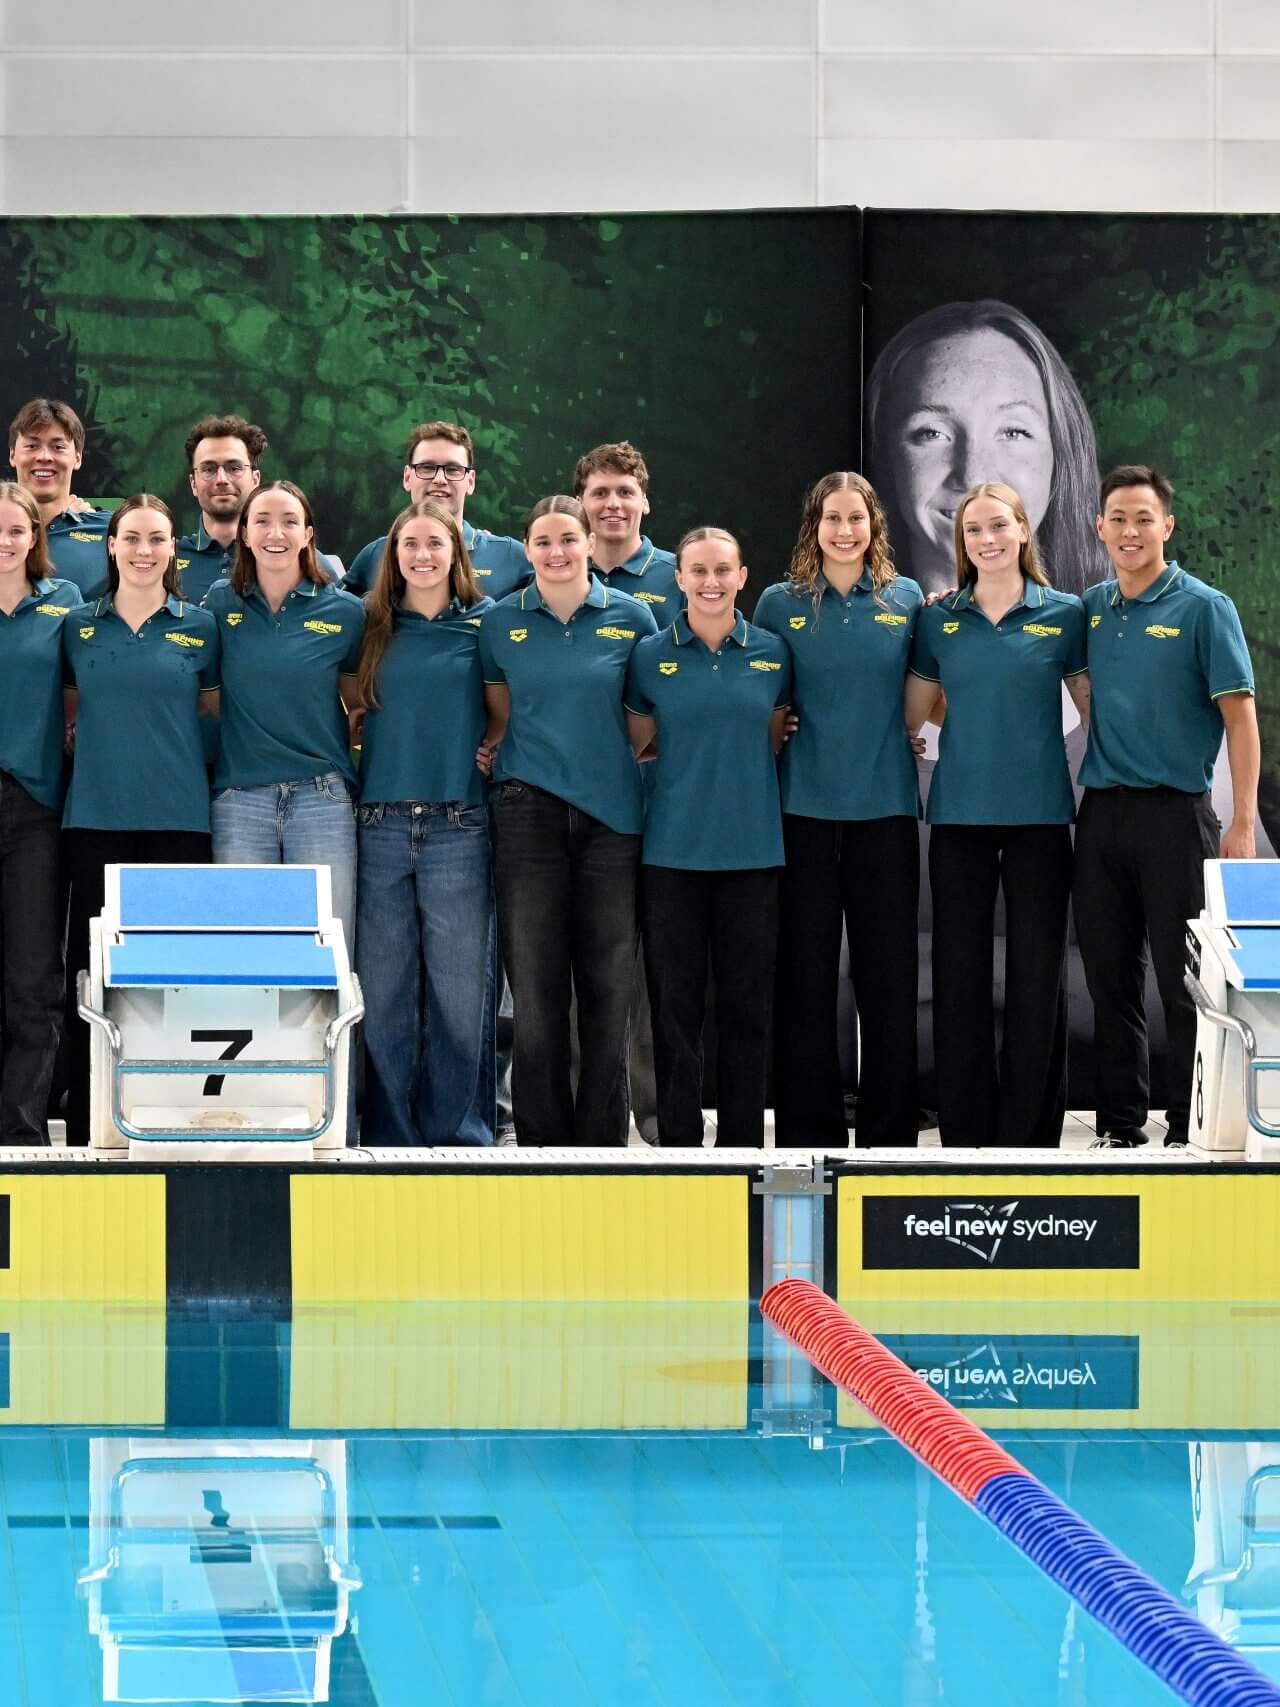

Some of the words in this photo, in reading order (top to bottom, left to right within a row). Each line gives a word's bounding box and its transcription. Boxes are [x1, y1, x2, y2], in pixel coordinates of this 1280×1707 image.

[190, 1029, 253, 1096] 7
[1196, 1050, 1204, 1131] 8
[904, 1214, 950, 1236] feel
[955, 1219, 1008, 1236] new
[1012, 1214, 1098, 1241] sydney
